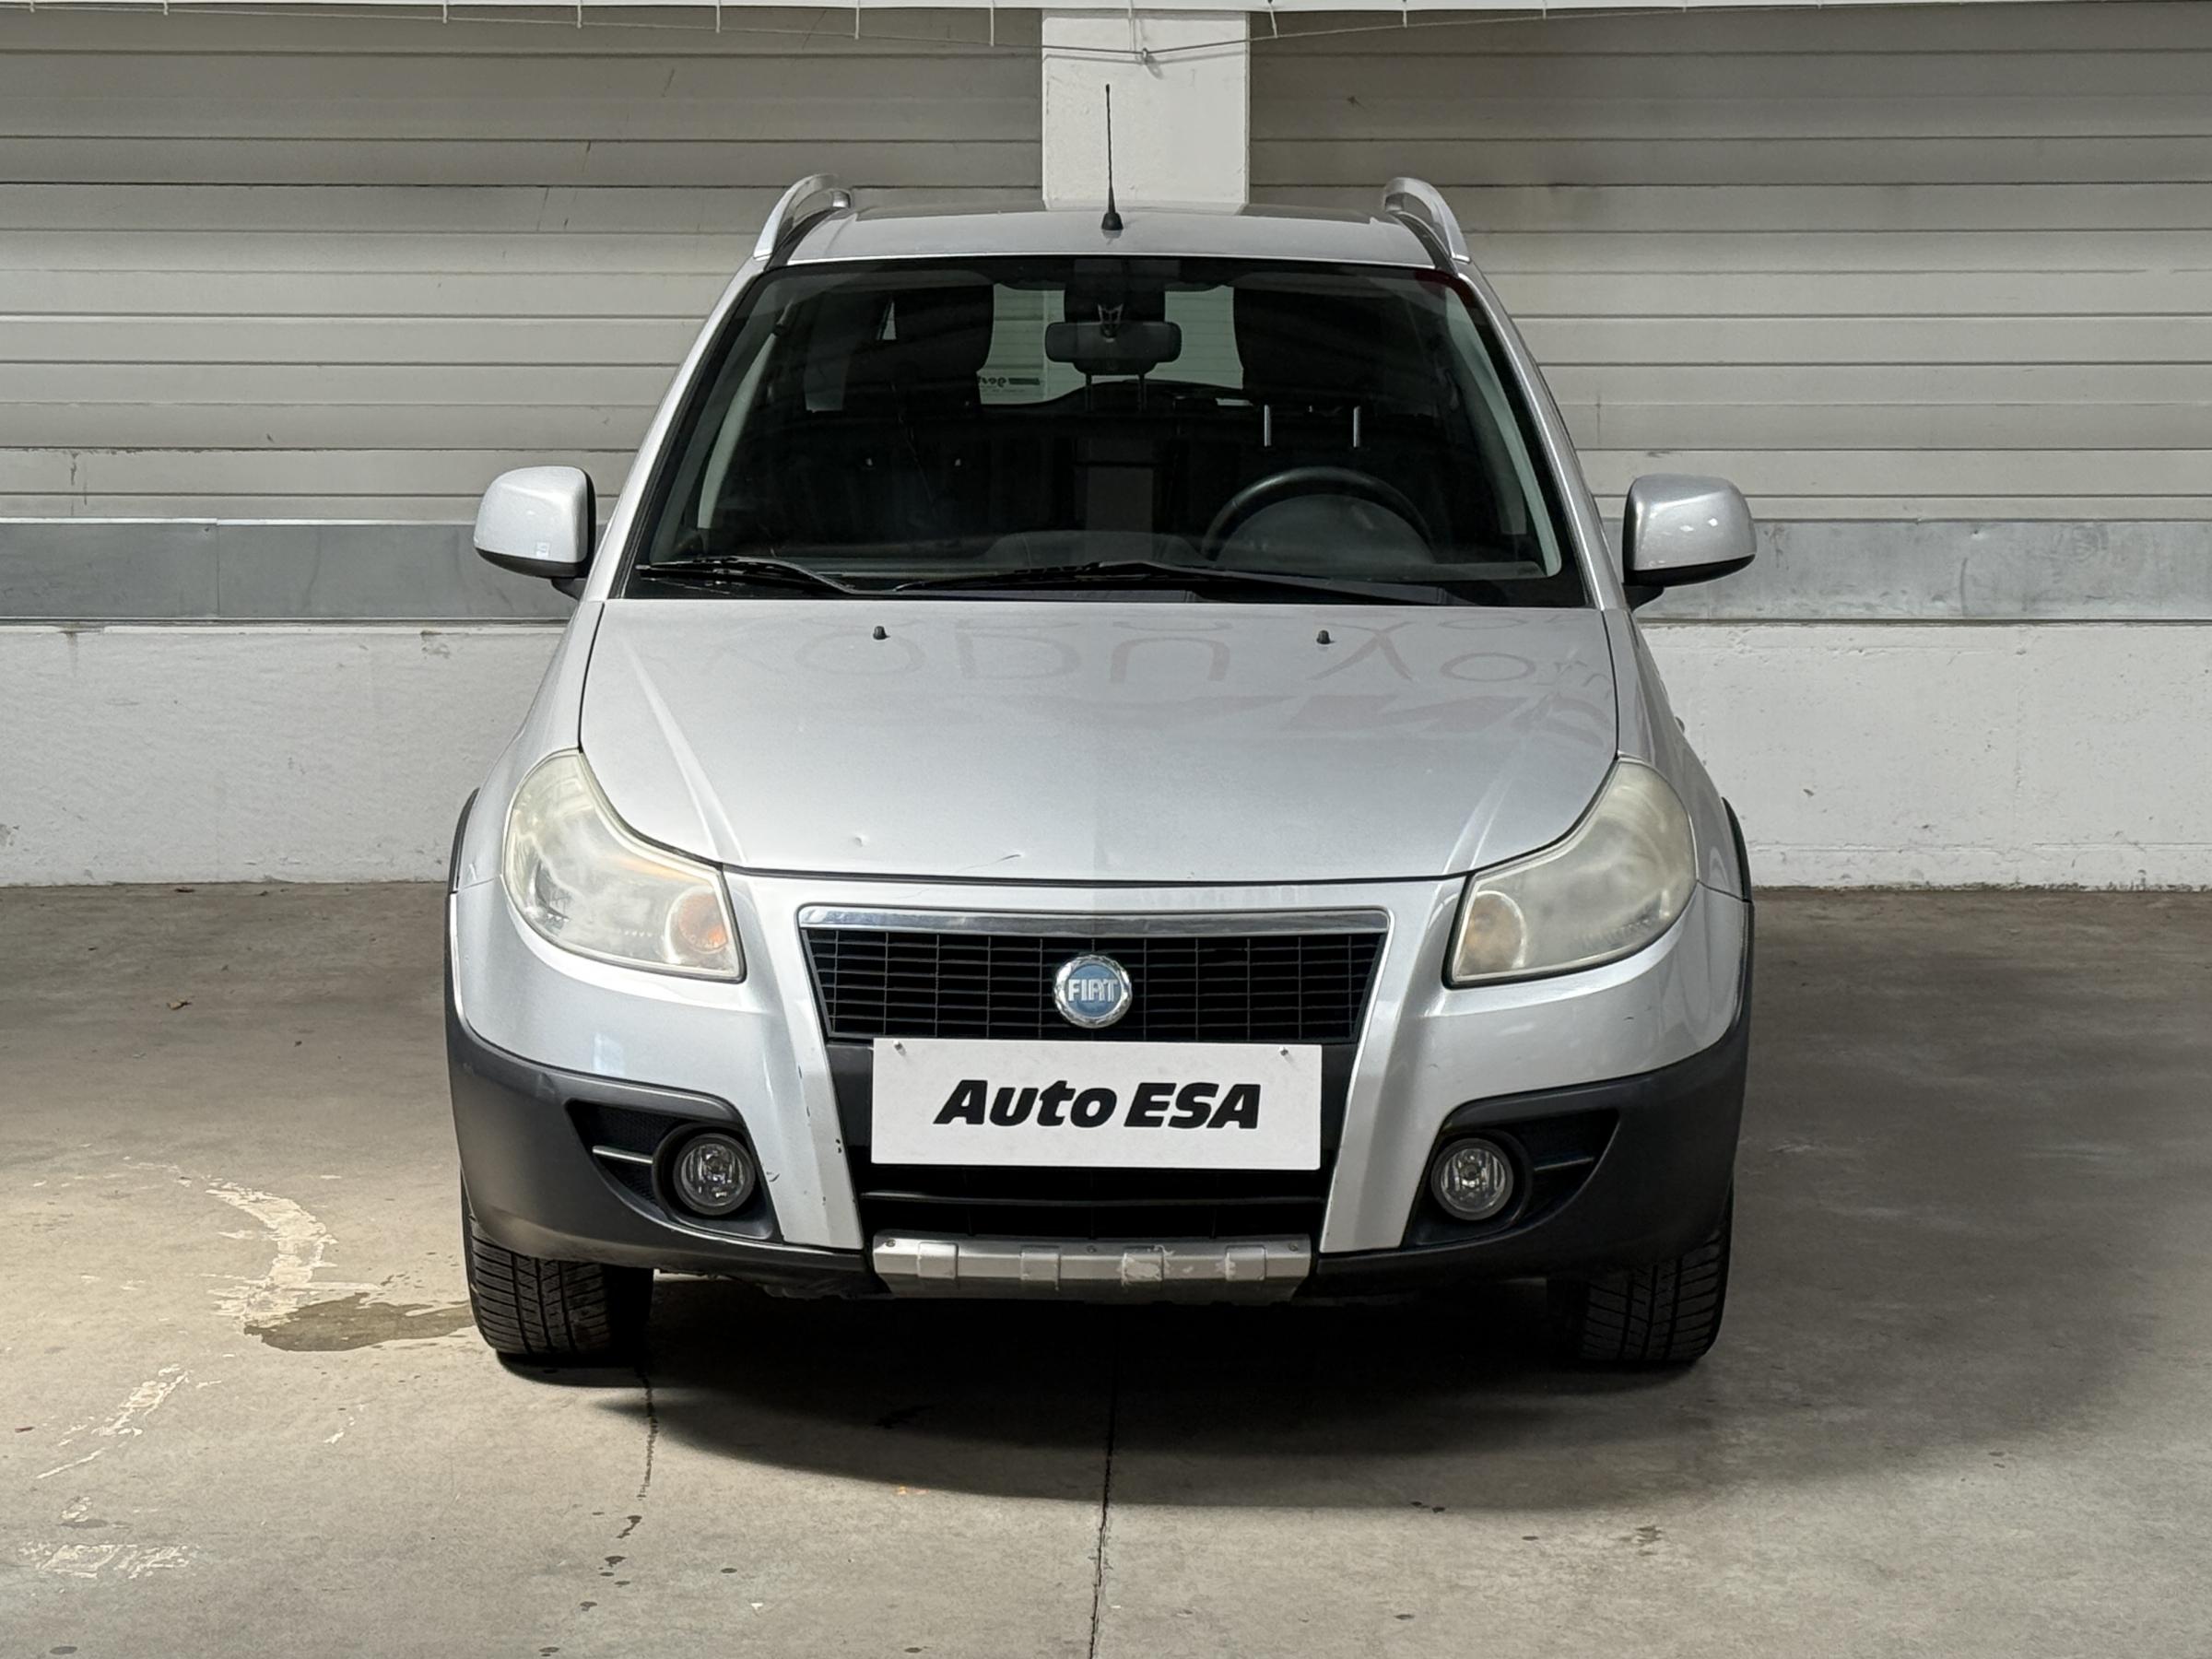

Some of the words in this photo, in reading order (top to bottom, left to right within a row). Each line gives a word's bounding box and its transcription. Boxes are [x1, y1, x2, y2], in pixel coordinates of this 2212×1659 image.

[1068, 978, 1118, 1002] FIAT
[933, 1079, 1118, 1128] Auto
[1124, 1082, 1261, 1129] ESA
